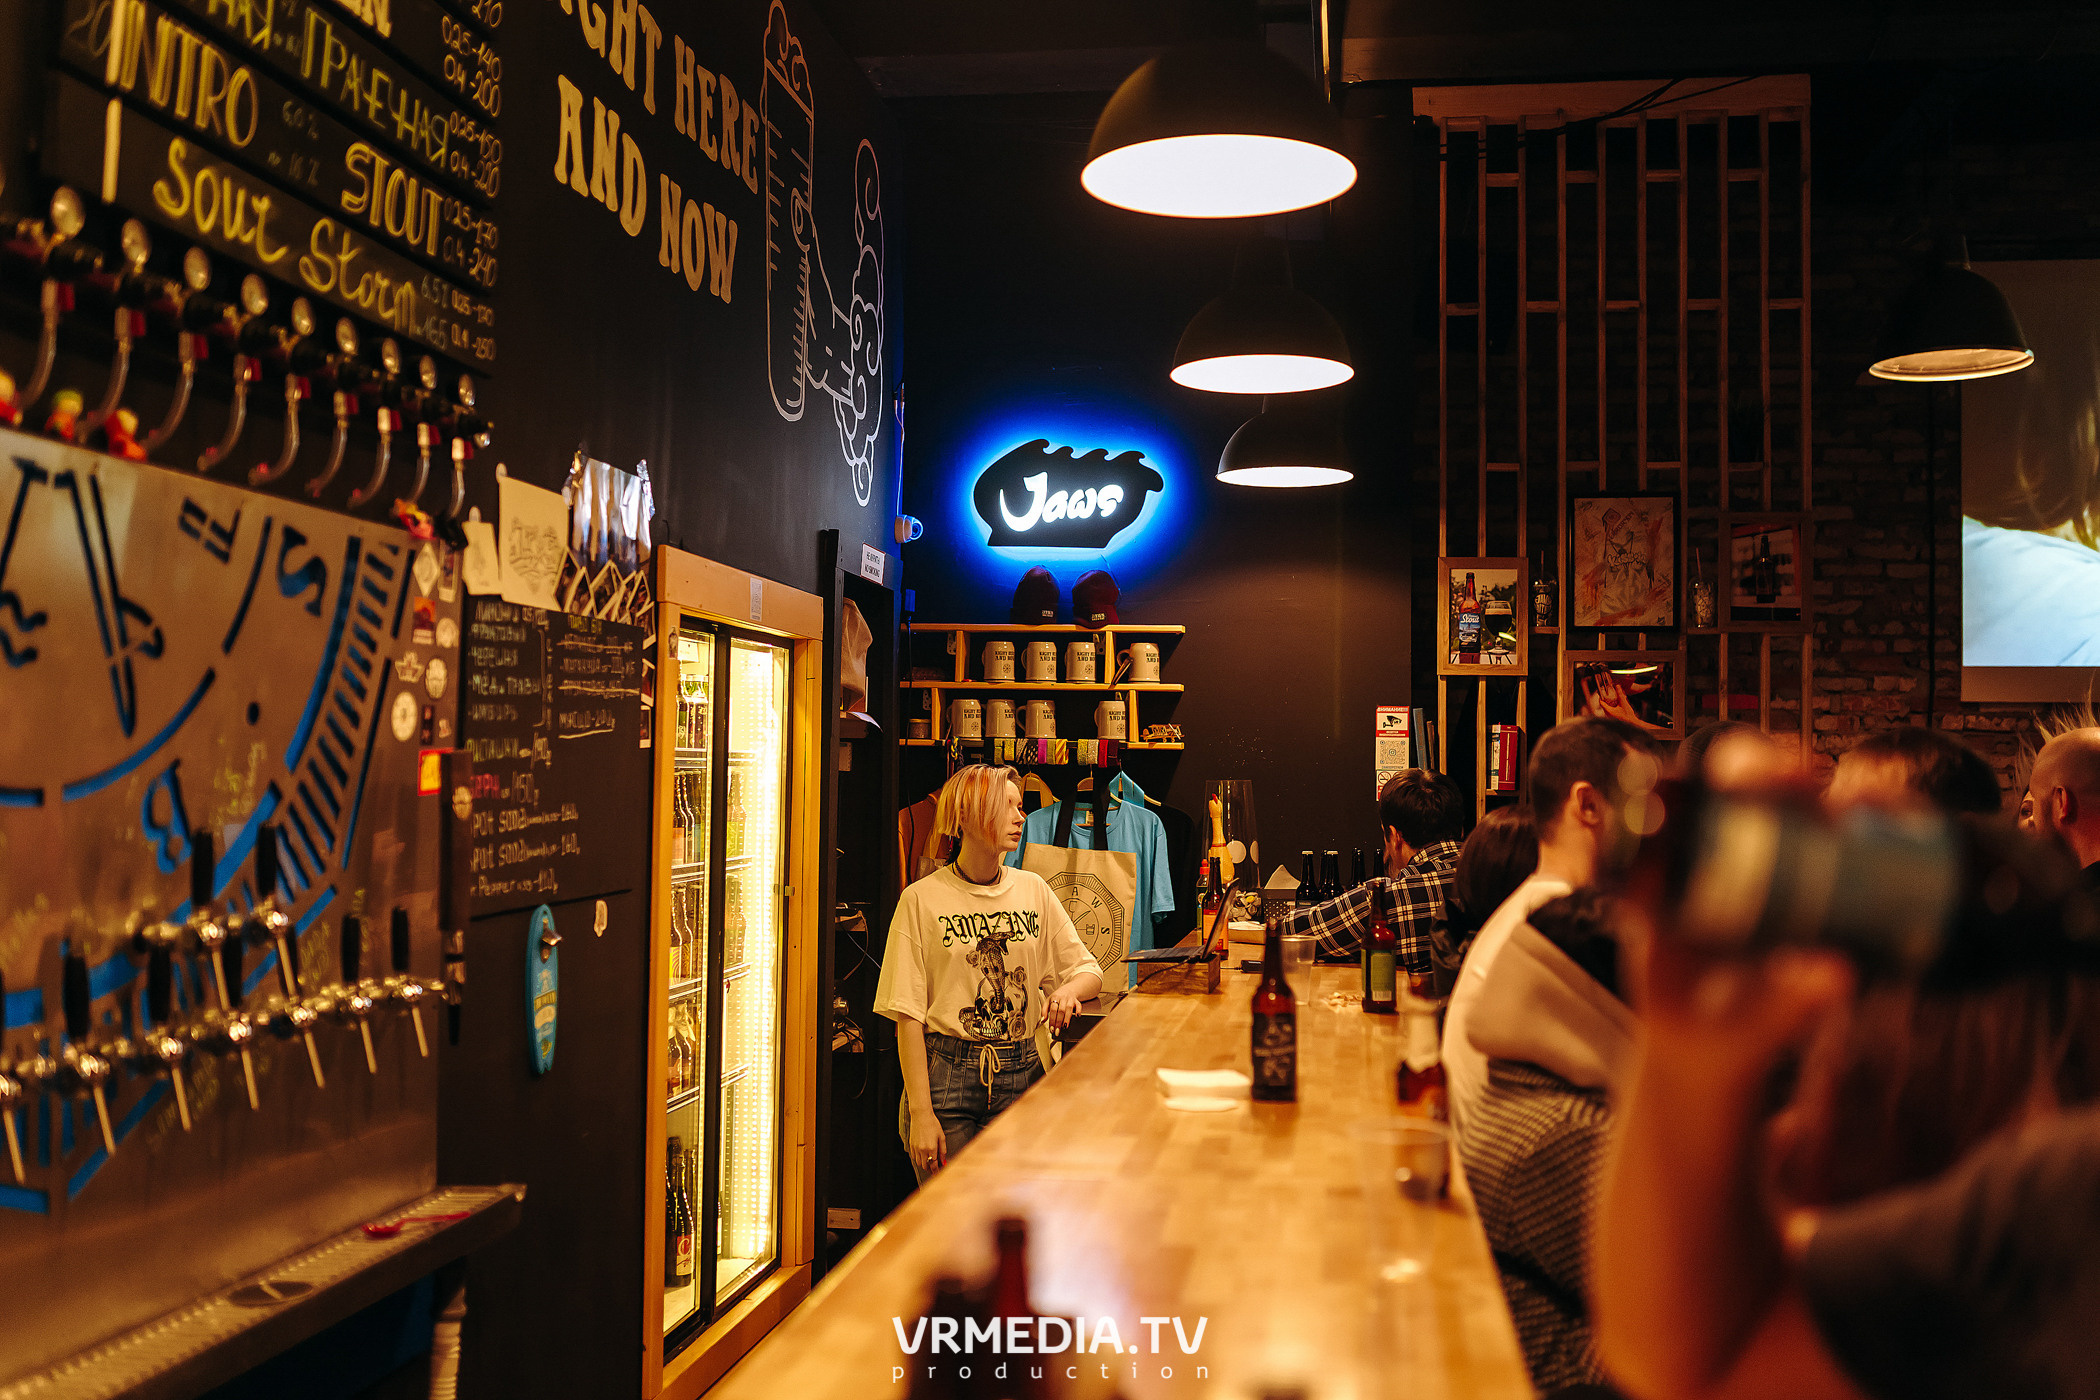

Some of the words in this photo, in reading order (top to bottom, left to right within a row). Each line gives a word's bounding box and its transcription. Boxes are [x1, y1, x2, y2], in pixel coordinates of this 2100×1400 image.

[674, 34, 760, 195] HERE
[153, 136, 290, 264] Sour
[299, 217, 420, 338] Storm
[341, 142, 444, 258] STOUT
[554, 74, 648, 238] AND
[659, 173, 739, 305] NOW
[1000, 471, 1124, 532] Jaws
[938, 909, 1040, 948] AMAZING
